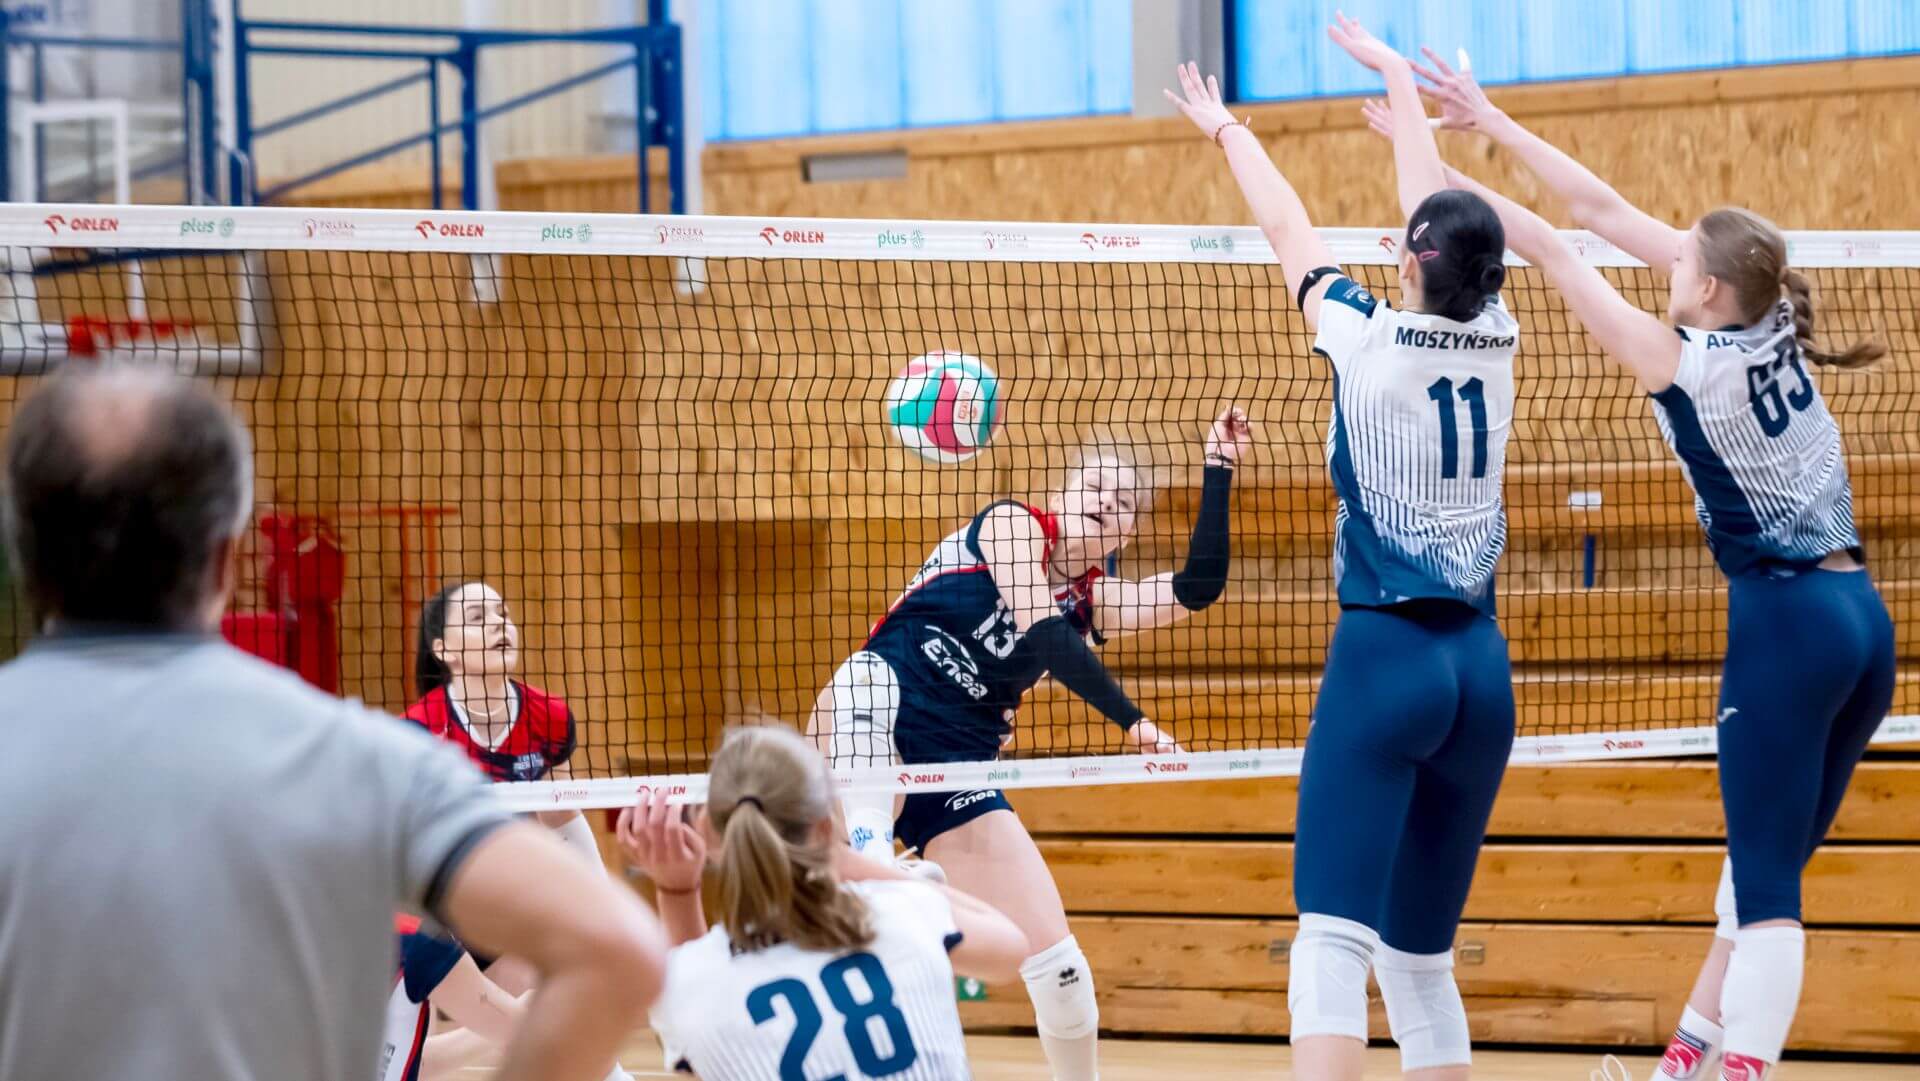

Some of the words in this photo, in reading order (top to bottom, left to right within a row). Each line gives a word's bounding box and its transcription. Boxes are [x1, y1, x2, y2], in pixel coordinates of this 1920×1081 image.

[70, 218, 119, 232] ORLEN
[180, 217, 216, 237] plus
[439, 223, 485, 238] ORLEN
[541, 223, 574, 242] plus
[783, 231, 825, 244] ORLEN
[878, 230, 907, 248] plus
[1190, 236, 1218, 253] plus
[1747, 334, 1814, 438] 63
[1427, 376, 1488, 479] 11
[921, 638, 988, 700] Enea
[1159, 763, 1188, 774] ORLEN
[1229, 759, 1249, 772] plus
[914, 773, 944, 784] ORLEN
[987, 768, 1008, 782] plus
[654, 786, 686, 796] LEN
[953, 789, 997, 811] Enea
[746, 951, 917, 1081] 28
